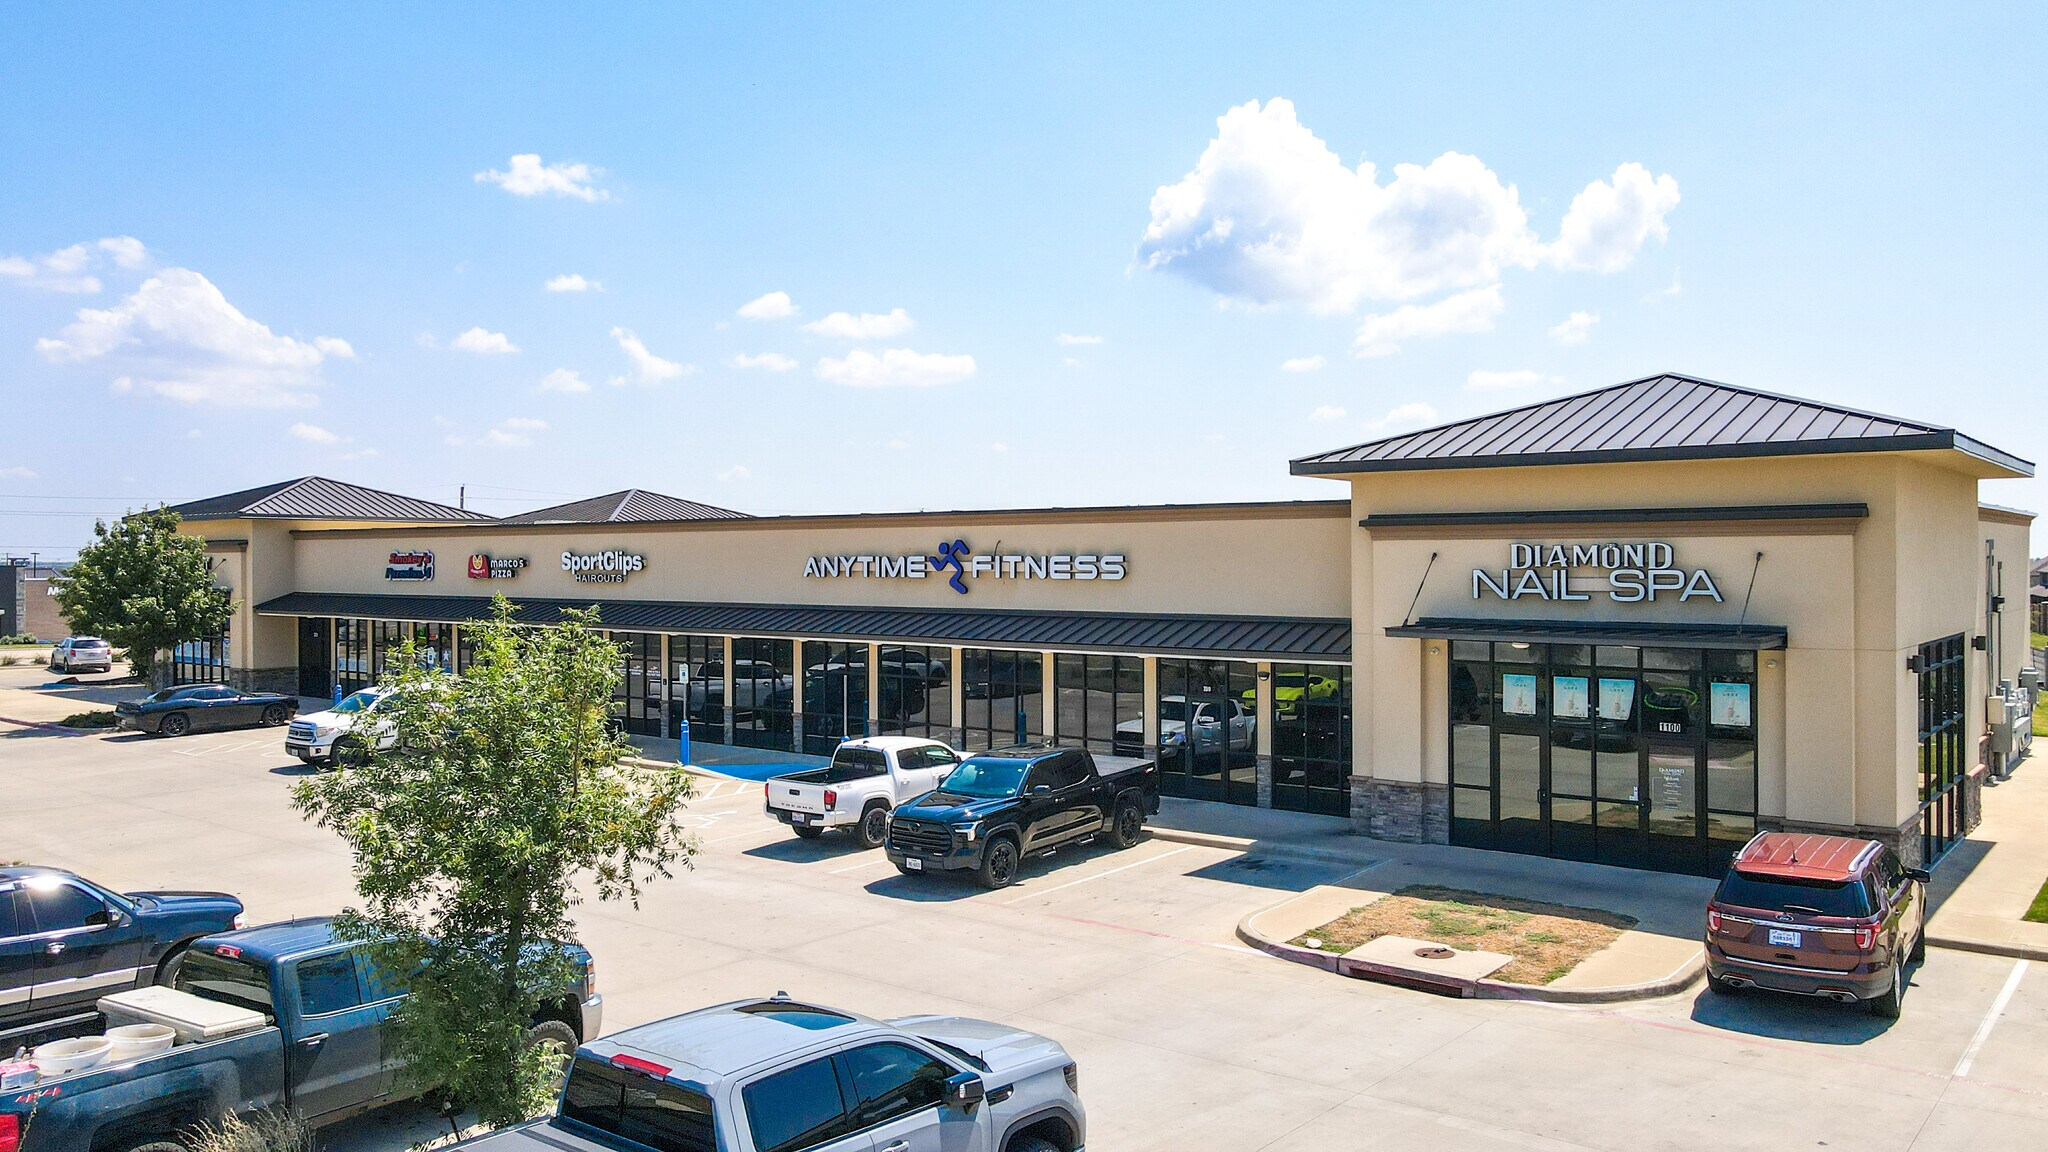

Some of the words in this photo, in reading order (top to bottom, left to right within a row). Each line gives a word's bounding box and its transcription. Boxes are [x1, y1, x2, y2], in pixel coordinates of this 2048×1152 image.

[490, 558, 525, 568] MARCO'S
[561, 551, 644, 576] SportClips
[802, 555, 927, 579] ANYTIME
[972, 555, 1127, 580] FITNESS
[1510, 543, 1674, 570] DIAMOND
[491, 569, 513, 578] PIZZA
[1472, 569, 1591, 601] NAIL
[1609, 569, 1725, 603] SPA
[1660, 722, 1681, 732] 1100
